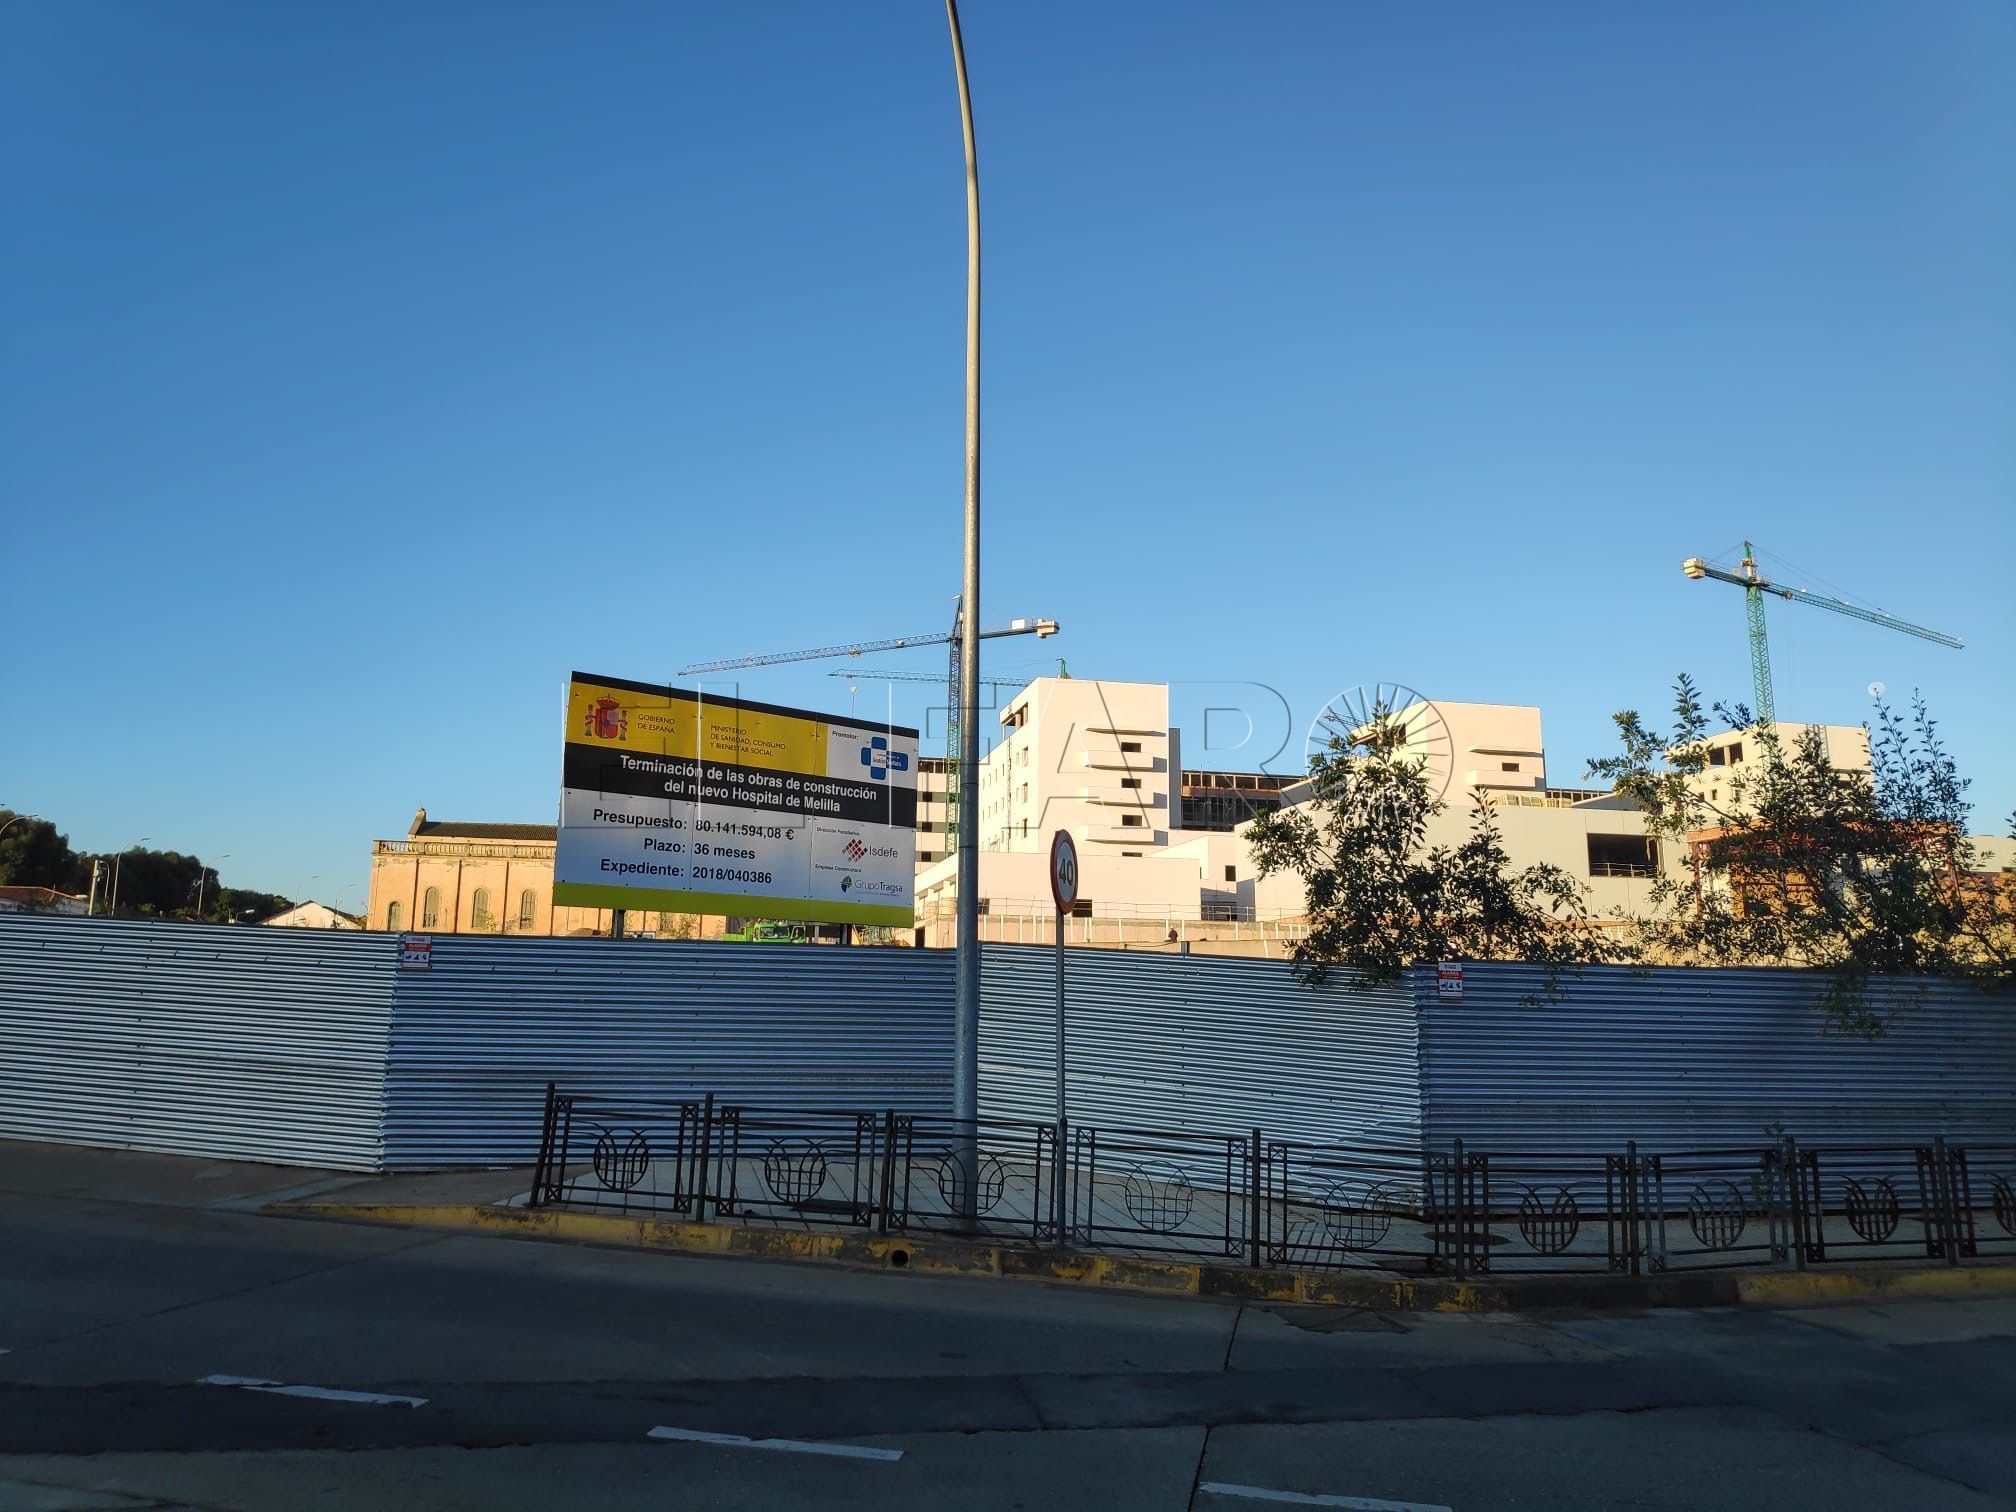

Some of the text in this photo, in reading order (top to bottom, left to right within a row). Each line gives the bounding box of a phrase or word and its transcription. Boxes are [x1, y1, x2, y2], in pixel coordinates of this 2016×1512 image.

[637, 722, 675, 734] DE ESPAÑA
[638, 713, 676, 725] GOBIERNO
[710, 724, 747, 736] MINISTERIO
[716, 743, 749, 753] BIENESTAR
[750, 748, 774, 756] SOCIAL
[752, 739, 786, 750] CONSUMO
[620, 754, 877, 801] Terminación de las obras de construcción
[664, 779, 841, 813] del nuevo Hospital de Melilla
[593, 808, 795, 841] Presupuesto: 80.141.594,08 €
[644, 837, 756, 861] Plazo: 36 meses
[869, 844, 899, 859] Isdefe
[600, 858, 773, 885] Expediente: 2018/040386
[1058, 858, 1074, 887] 40
